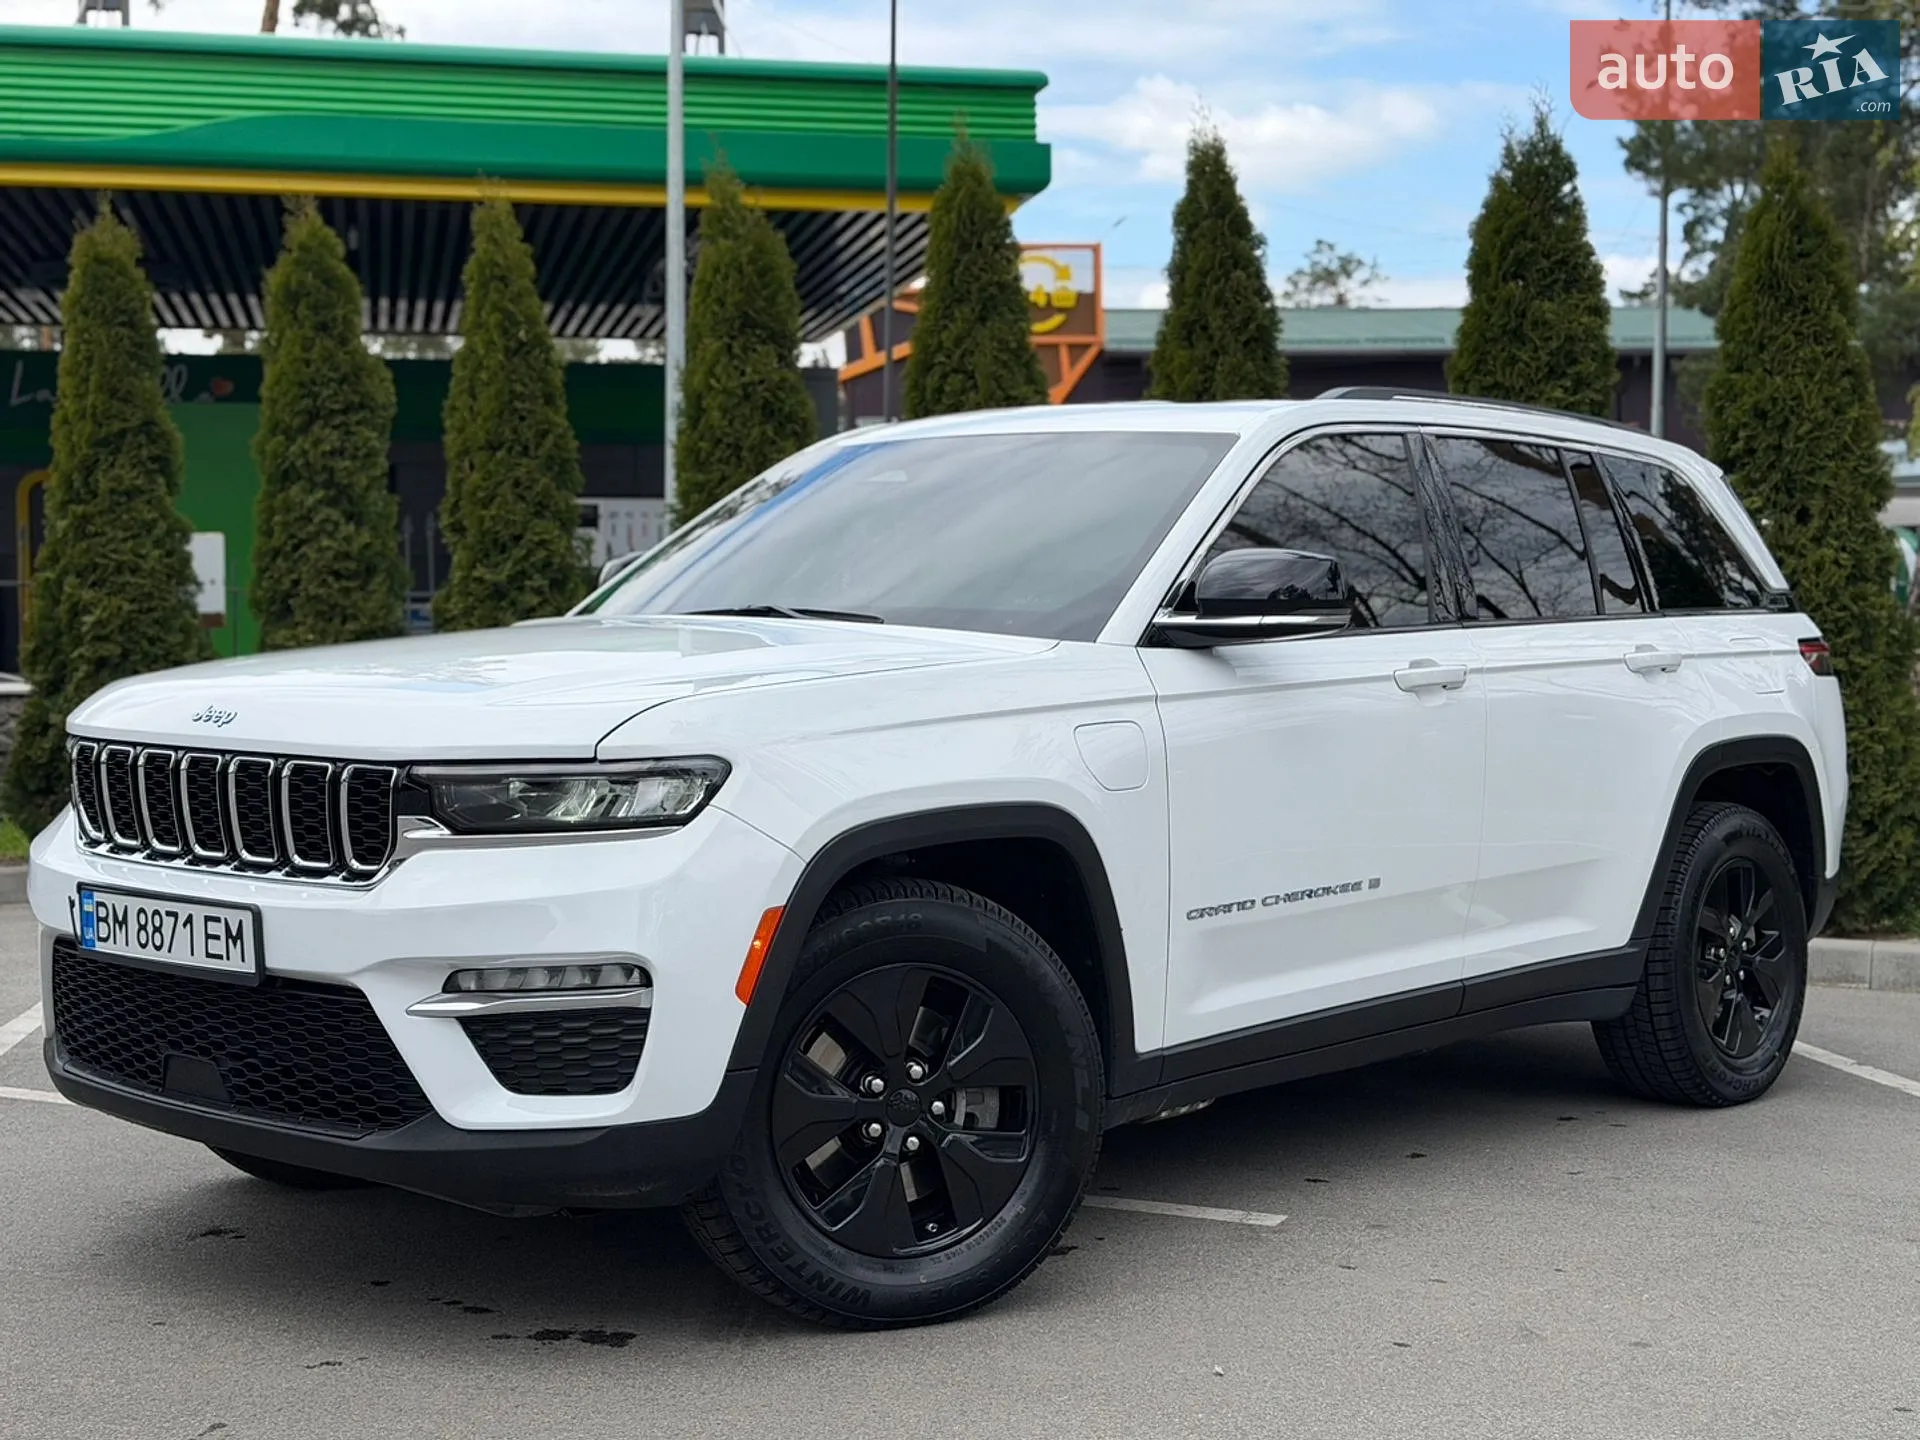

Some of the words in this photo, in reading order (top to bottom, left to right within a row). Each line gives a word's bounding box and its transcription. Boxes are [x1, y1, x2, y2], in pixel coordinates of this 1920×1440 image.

[192, 705, 238, 728] Jeep
[1186, 898, 1256, 921] GRAND
[1261, 880, 1363, 907] CHEROKEE
[96, 901, 129, 947] BM
[136, 907, 194, 957] 8871
[204, 914, 245, 963] EM
